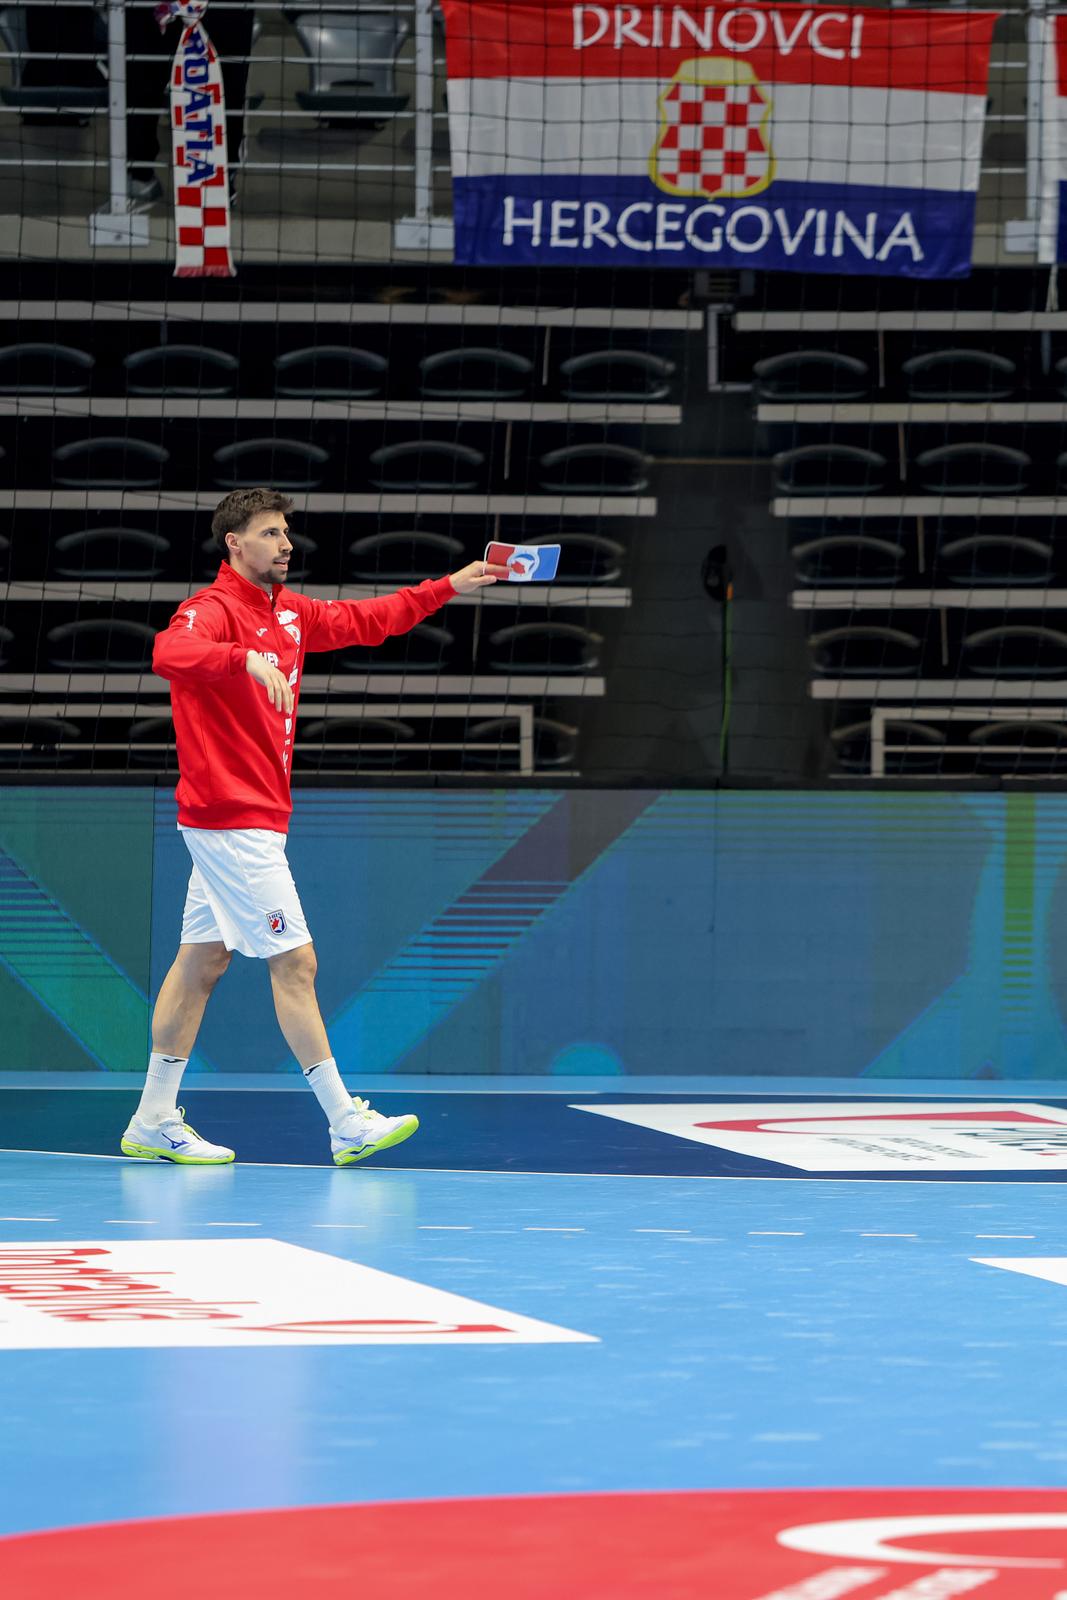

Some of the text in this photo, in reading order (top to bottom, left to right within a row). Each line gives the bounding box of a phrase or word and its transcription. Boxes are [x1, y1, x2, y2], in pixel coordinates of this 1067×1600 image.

[572, 4, 865, 59] DRINOVCI
[183, 30, 215, 185] ROATIA
[501, 196, 924, 262] HERCEGOVINA
